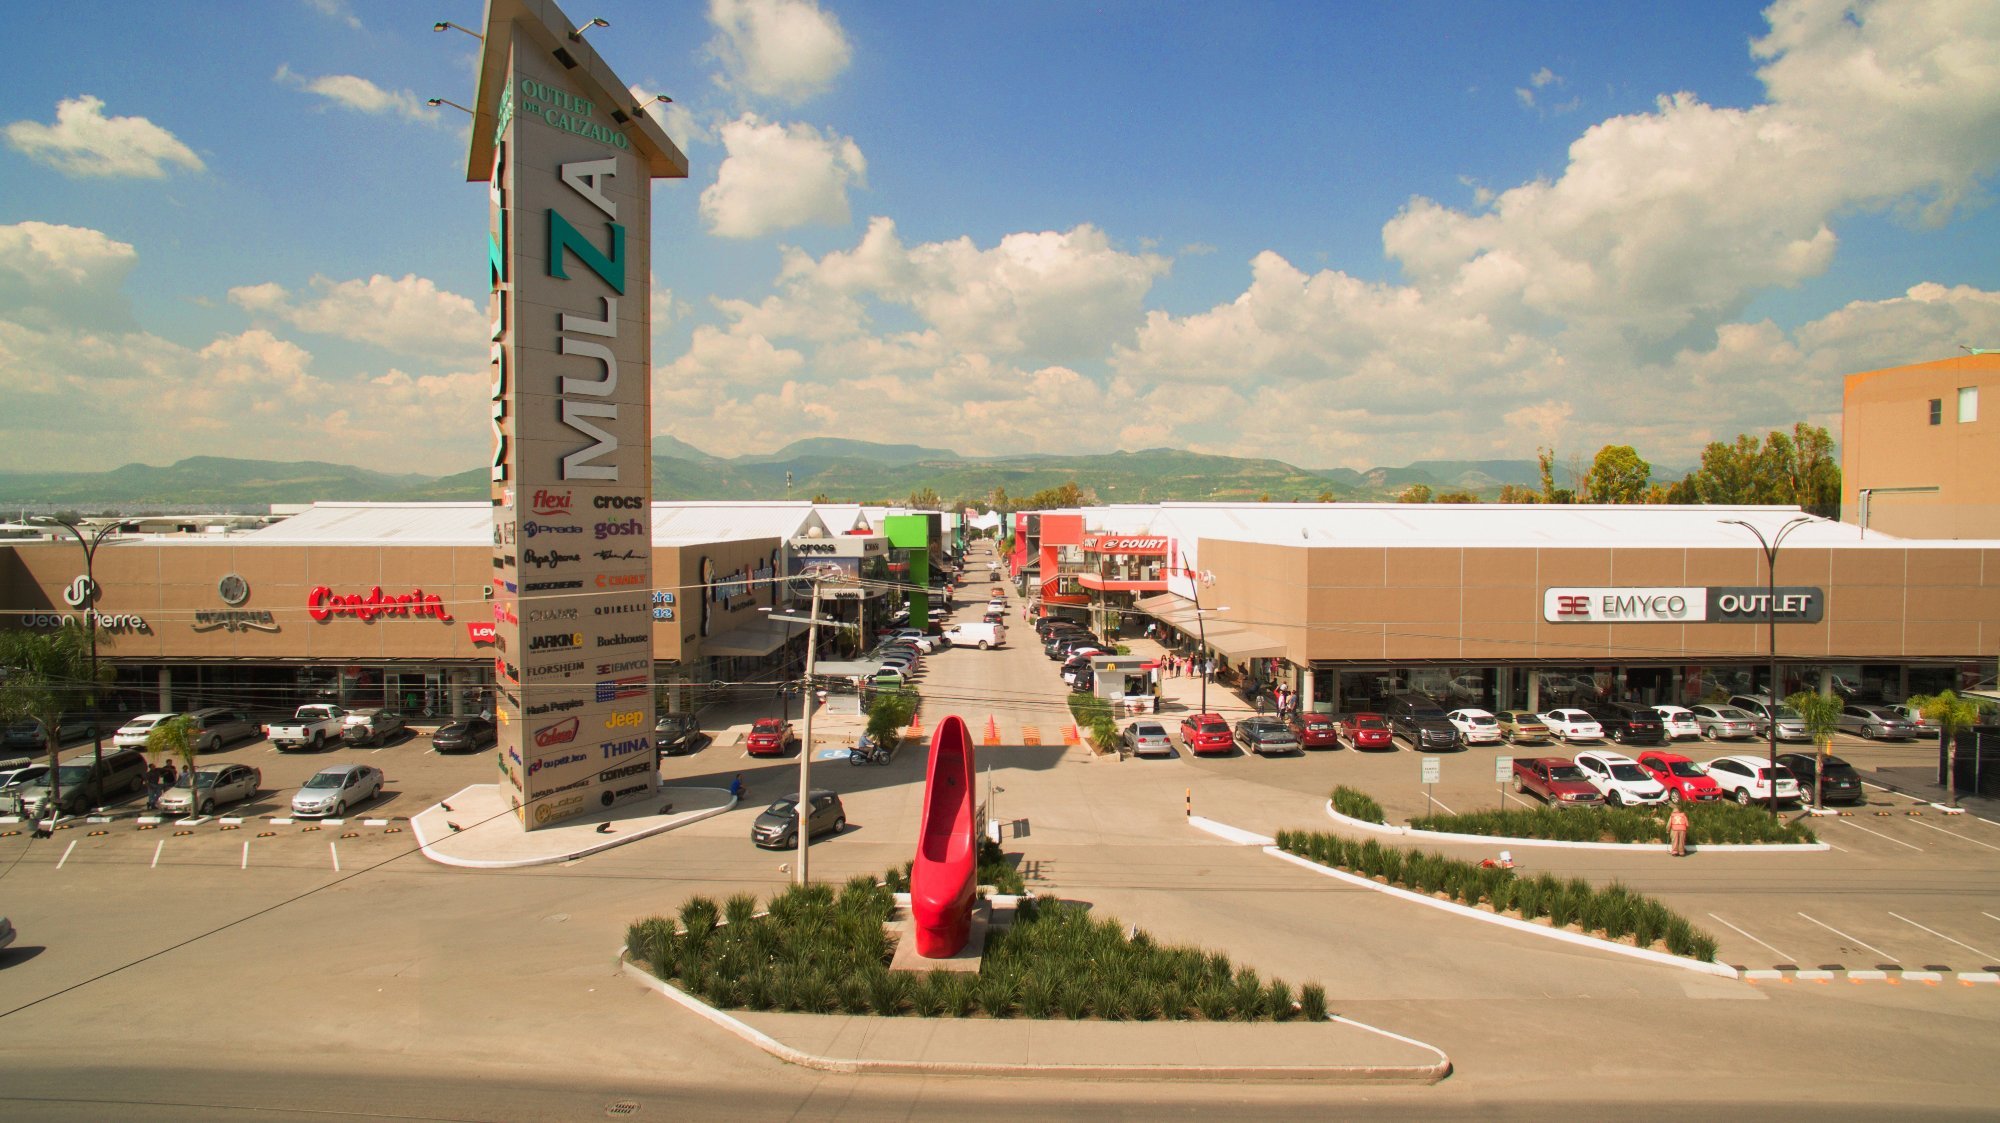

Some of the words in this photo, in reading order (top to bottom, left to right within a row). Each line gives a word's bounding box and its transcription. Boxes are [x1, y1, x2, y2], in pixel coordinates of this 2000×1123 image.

[521, 79, 595, 117] OUTLET
[544, 108, 629, 150] CALZADO
[547, 156, 625, 481] MULZA
[533, 489, 571, 508] flexi
[593, 495, 643, 509] crocs
[1120, 539, 1167, 549] COURT
[594, 603, 646, 615] QUIRELLI
[1602, 595, 1685, 613] EMYCO
[1719, 594, 1812, 612] OUTLET
[84, 608, 141, 628] Pierre
[597, 633, 648, 647] Buckhouse
[527, 661, 584, 677] FLORSHEIM
[615, 660, 648, 671] EMYCO
[605, 710, 644, 729] Jeep
[600, 762, 650, 782] CONVERSE
